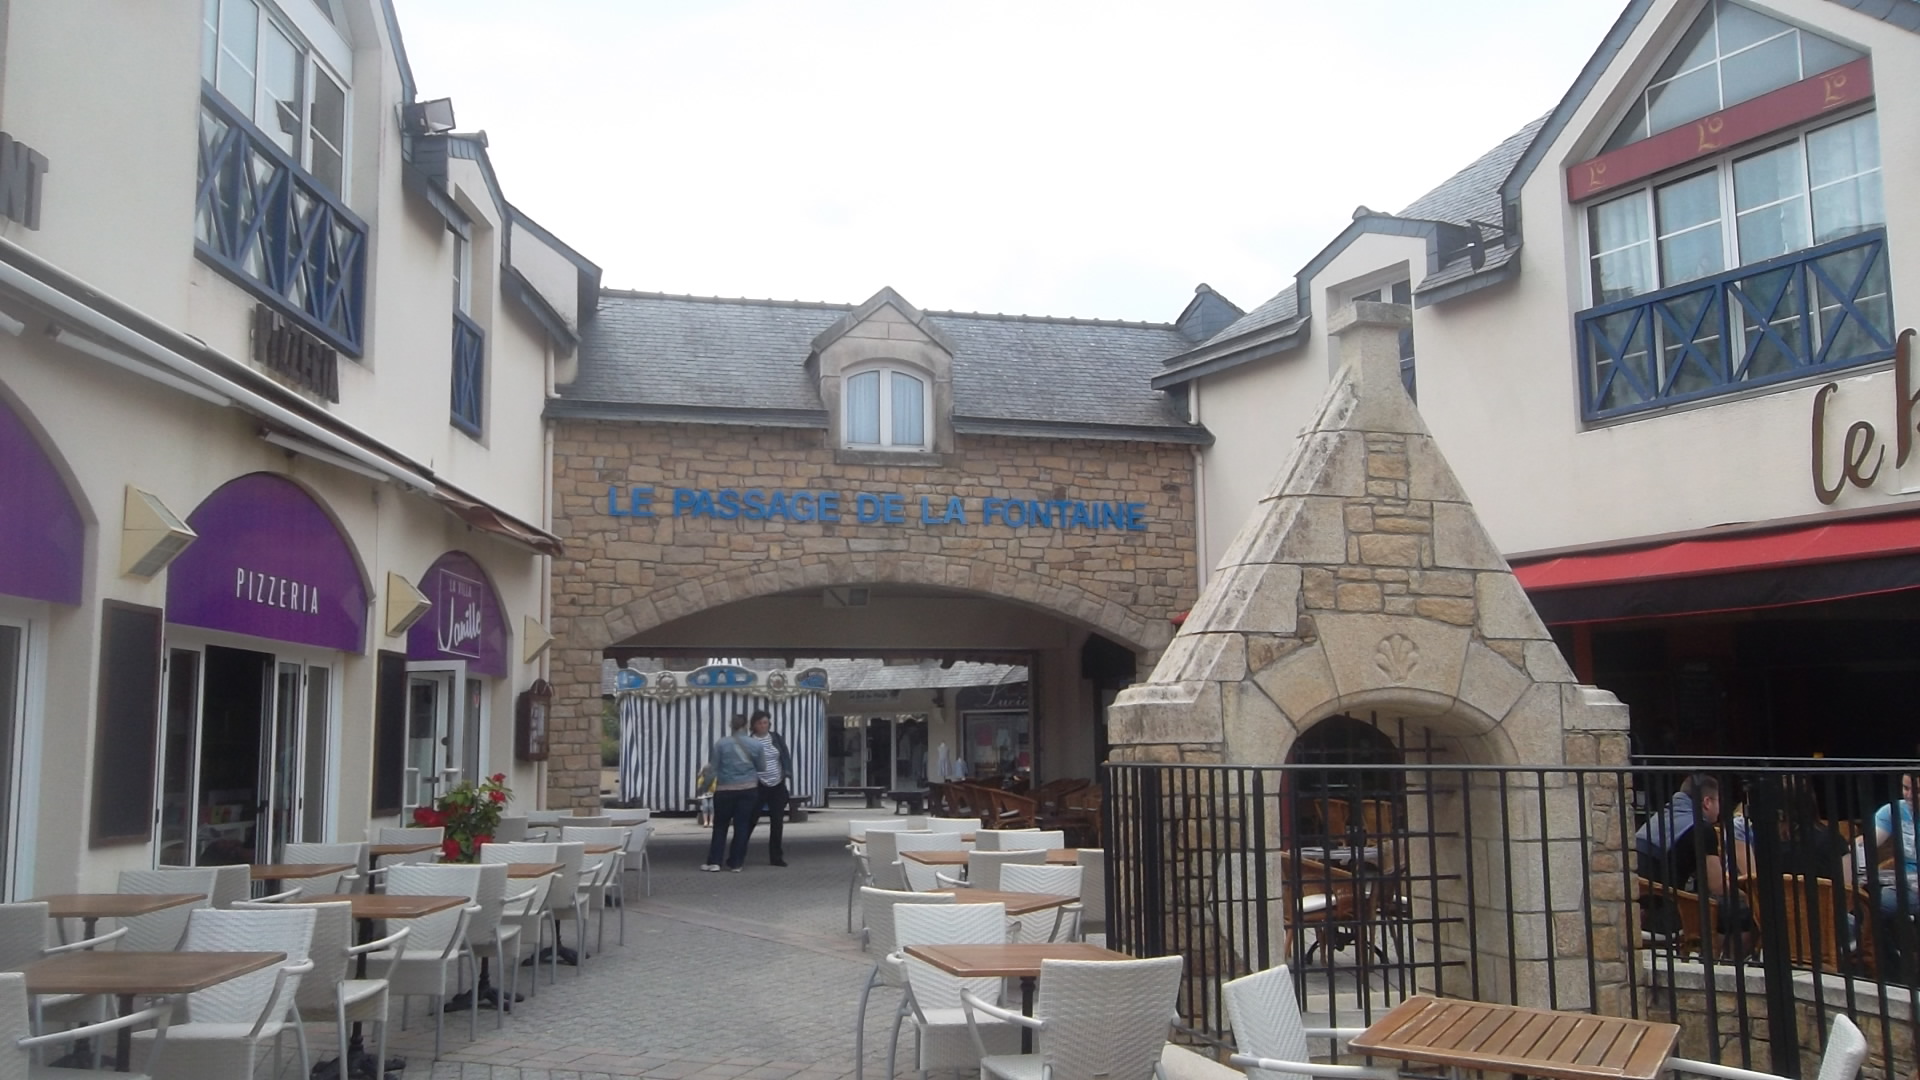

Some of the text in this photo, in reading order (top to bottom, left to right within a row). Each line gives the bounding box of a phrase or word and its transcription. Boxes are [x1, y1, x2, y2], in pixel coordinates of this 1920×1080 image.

[608, 484, 1148, 531] LE PASSAGE DE LA FONTAINE
[236, 567, 318, 614] PIZZERIA
